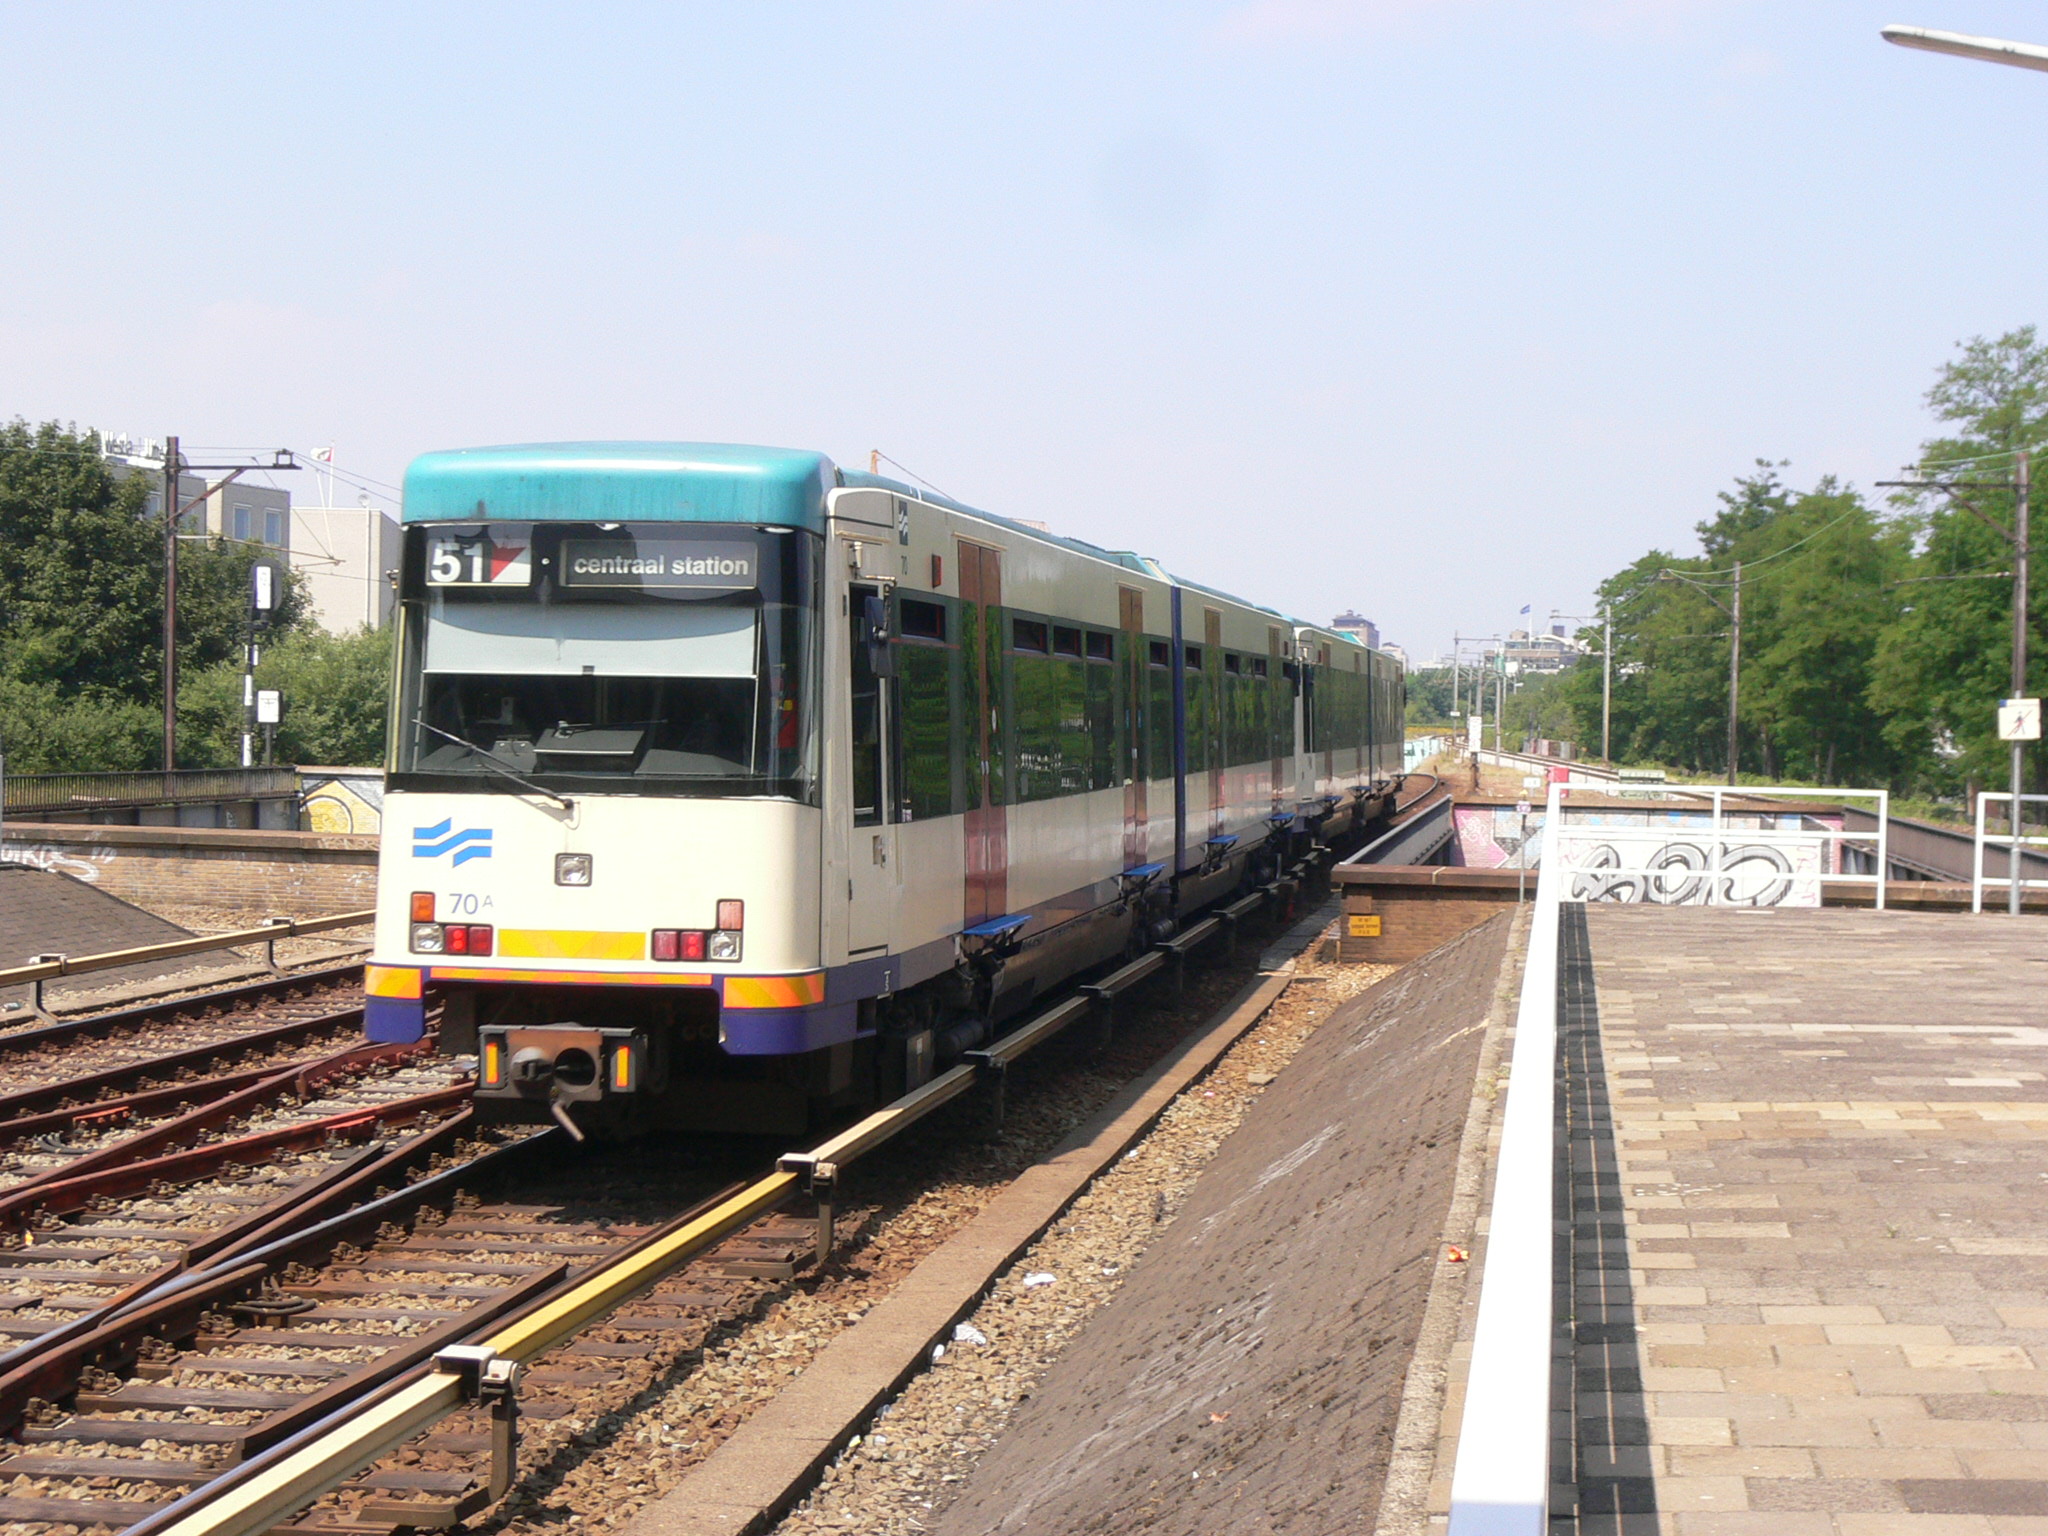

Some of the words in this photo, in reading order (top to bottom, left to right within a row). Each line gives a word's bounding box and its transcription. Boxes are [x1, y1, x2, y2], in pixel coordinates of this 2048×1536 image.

[431, 543, 483, 582] 51
[574, 555, 664, 574] centraal
[671, 556, 749, 575] station
